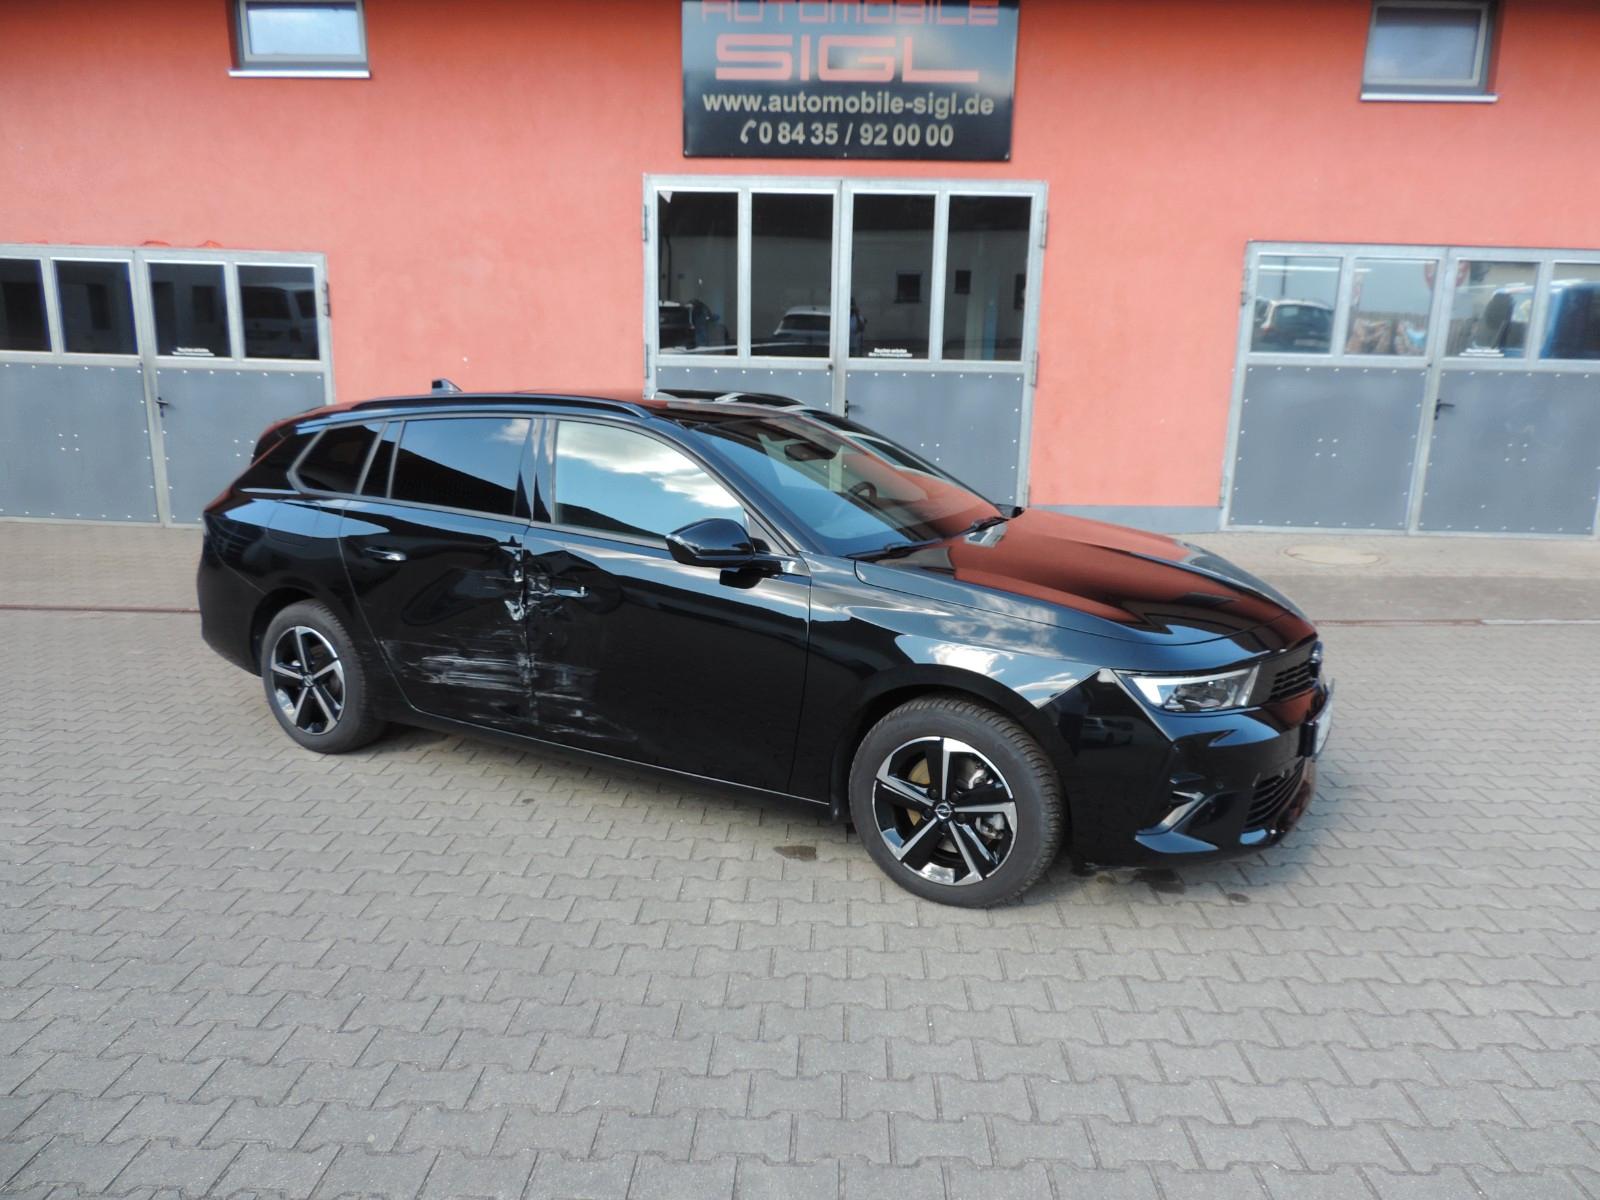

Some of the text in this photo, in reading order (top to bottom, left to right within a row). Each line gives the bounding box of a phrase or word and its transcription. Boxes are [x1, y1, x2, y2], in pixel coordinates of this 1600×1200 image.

[702, 0, 999, 26] AUTOMOBILE
[715, 34, 979, 83] SIGL
[702, 90, 994, 120] www.automobile-sigl.de
